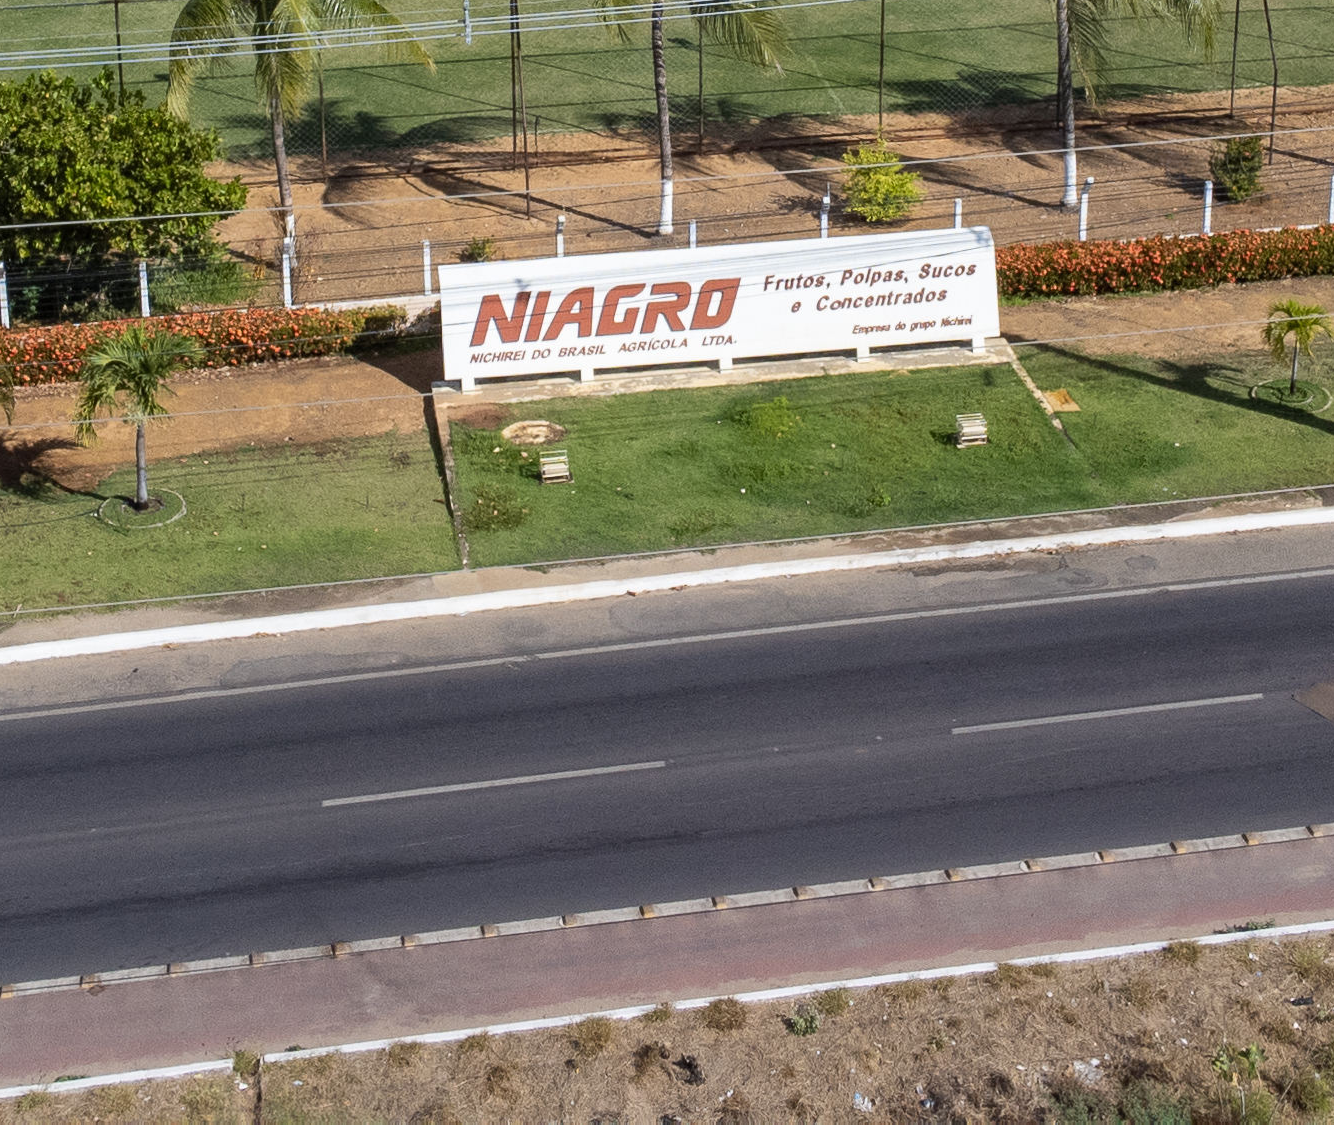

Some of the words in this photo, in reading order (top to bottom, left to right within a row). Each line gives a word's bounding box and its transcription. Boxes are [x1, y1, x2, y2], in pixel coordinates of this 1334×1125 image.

[763, 274, 830, 292] Frutos,
[840, 268, 909, 287] Polpas,
[918, 263, 977, 280] Sucos
[469, 278, 741, 348] NIAGRO
[791, 301, 801, 313] e
[816, 287, 948, 312] Concentrados
[852, 323, 891, 336] Empresa
[894, 321, 906, 331] do
[909, 319, 936, 332] grupo
[940, 314, 973, 328] Nichirei
[470, 349, 525, 364] NICHIREI
[531, 348, 551, 361] DO
[558, 344, 607, 358] BRASIL
[618, 337, 688, 353] AGRÍCOLA
[701, 335, 738, 347] LTDA.
